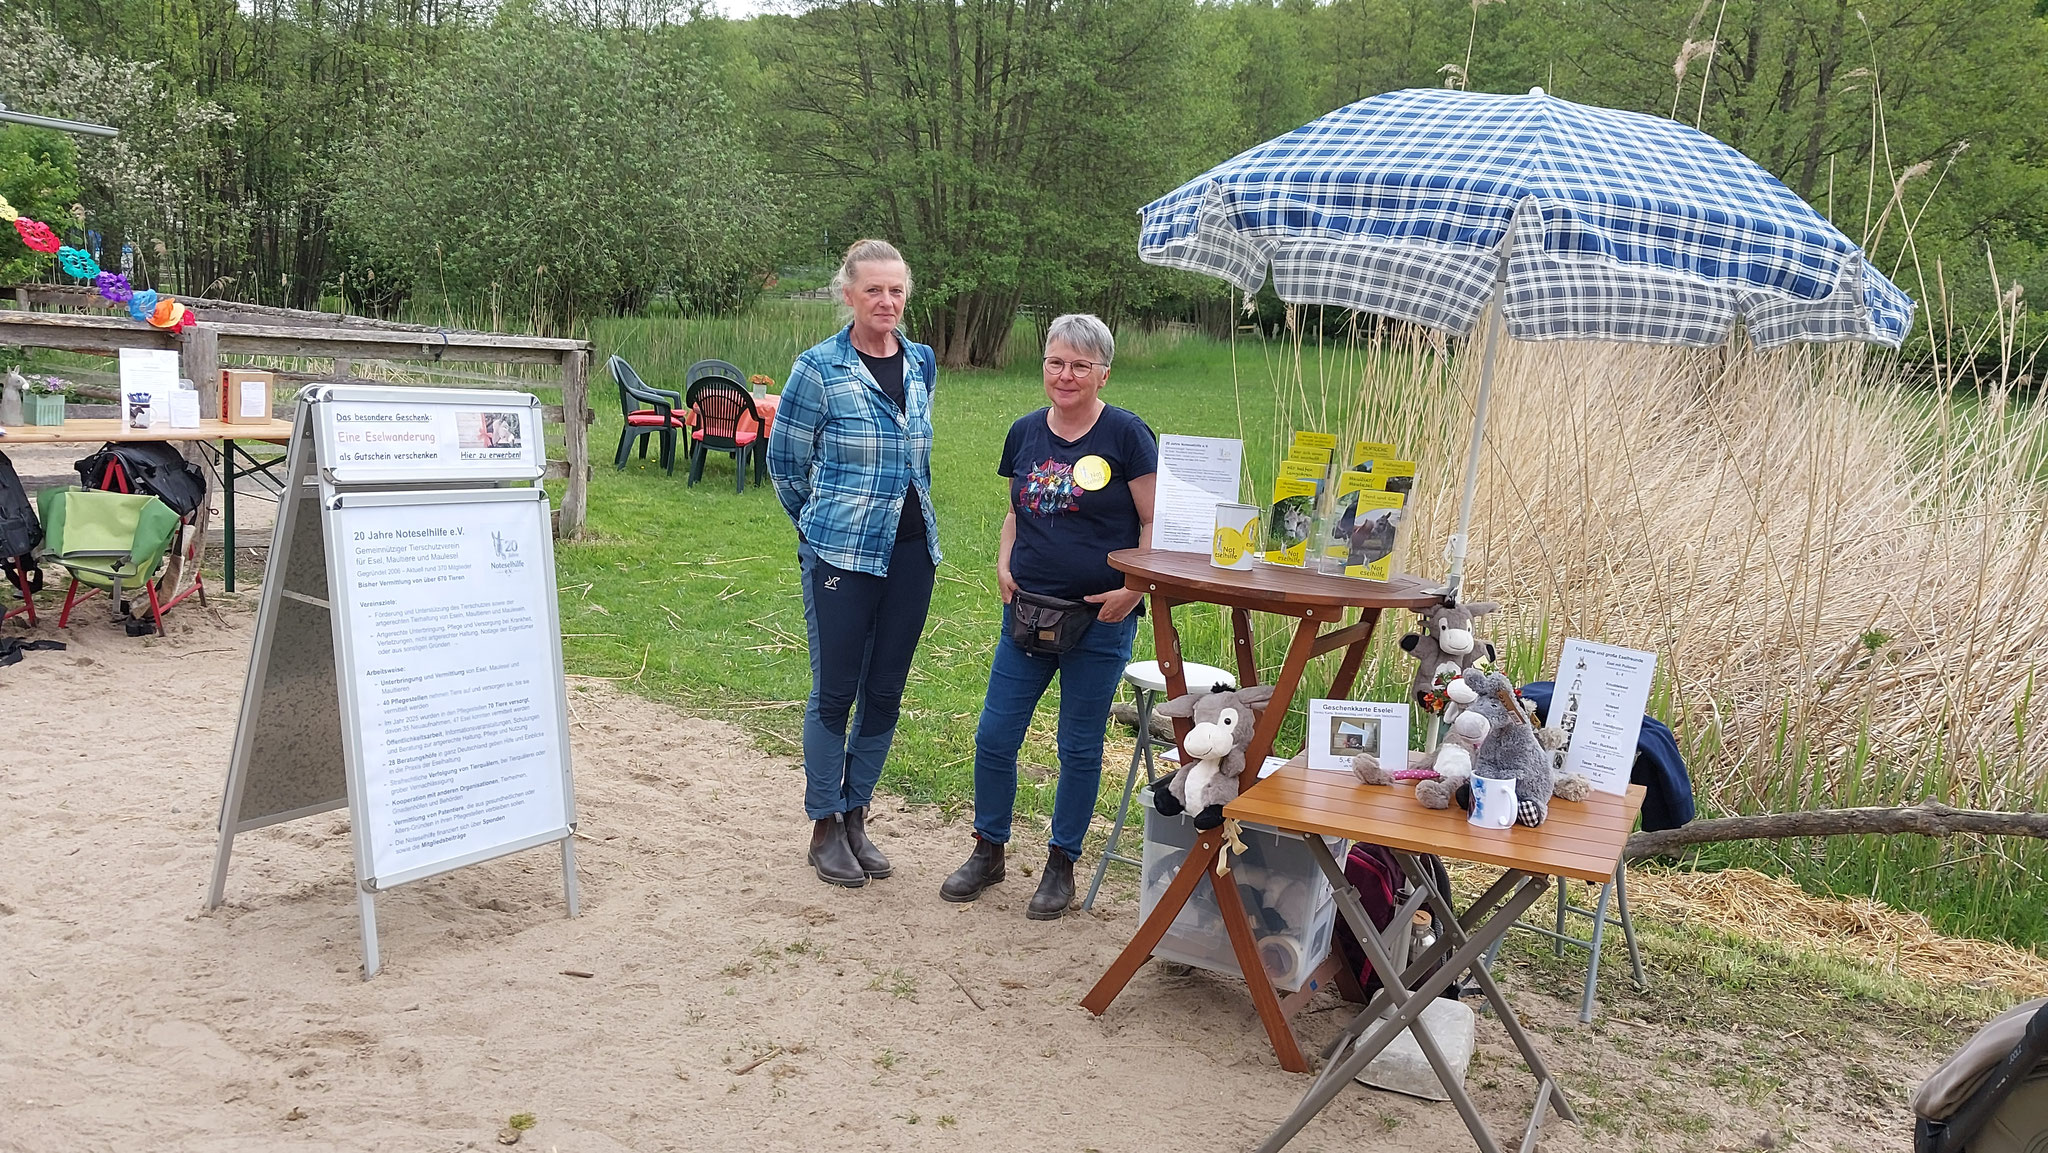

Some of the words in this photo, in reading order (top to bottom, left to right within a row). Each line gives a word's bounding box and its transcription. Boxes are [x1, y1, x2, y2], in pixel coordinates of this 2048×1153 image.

[336, 413, 351, 422] Das
[355, 414, 392, 422] besondere
[396, 413, 432, 421] Geschenk:
[338, 432, 361, 442] Eine
[366, 432, 435, 444] Eselwanderung
[354, 452, 391, 460] Gutschein
[353, 532, 365, 540] 20
[367, 531, 393, 540] Jahre
[396, 528, 447, 538] Noteselhilfe
[450, 527, 464, 536] e.V.
[354, 546, 406, 555] Gemeinnütziger
[409, 542, 459, 552] Tierschutzverein
[504, 539, 518, 552] 20
[386, 555, 415, 563] Maultiere
[430, 552, 458, 560] Maulesel
[1215, 552, 1238, 560] eselhilfe
[490, 559, 524, 569] Noteselhilfe
[1360, 570, 1385, 578] eselhilfe
[1618, 654, 1644, 663] Eselfreunde
[380, 676, 422, 686] Unterbringung
[435, 670, 464, 678] Vermittlung
[391, 695, 427, 705] Pflegestellen
[1323, 704, 1371, 713] Geschenkkarte
[396, 752, 436, 764] Beratungshöfe
[428, 768, 457, 778] Verfolgung
[392, 795, 426, 807] Kooperation
[437, 788, 458, 796] anderen
[393, 814, 425, 826] Vermittlung
[482, 815, 505, 825] Spenden
[421, 833, 466, 848] Mitgliedsbeiträge
